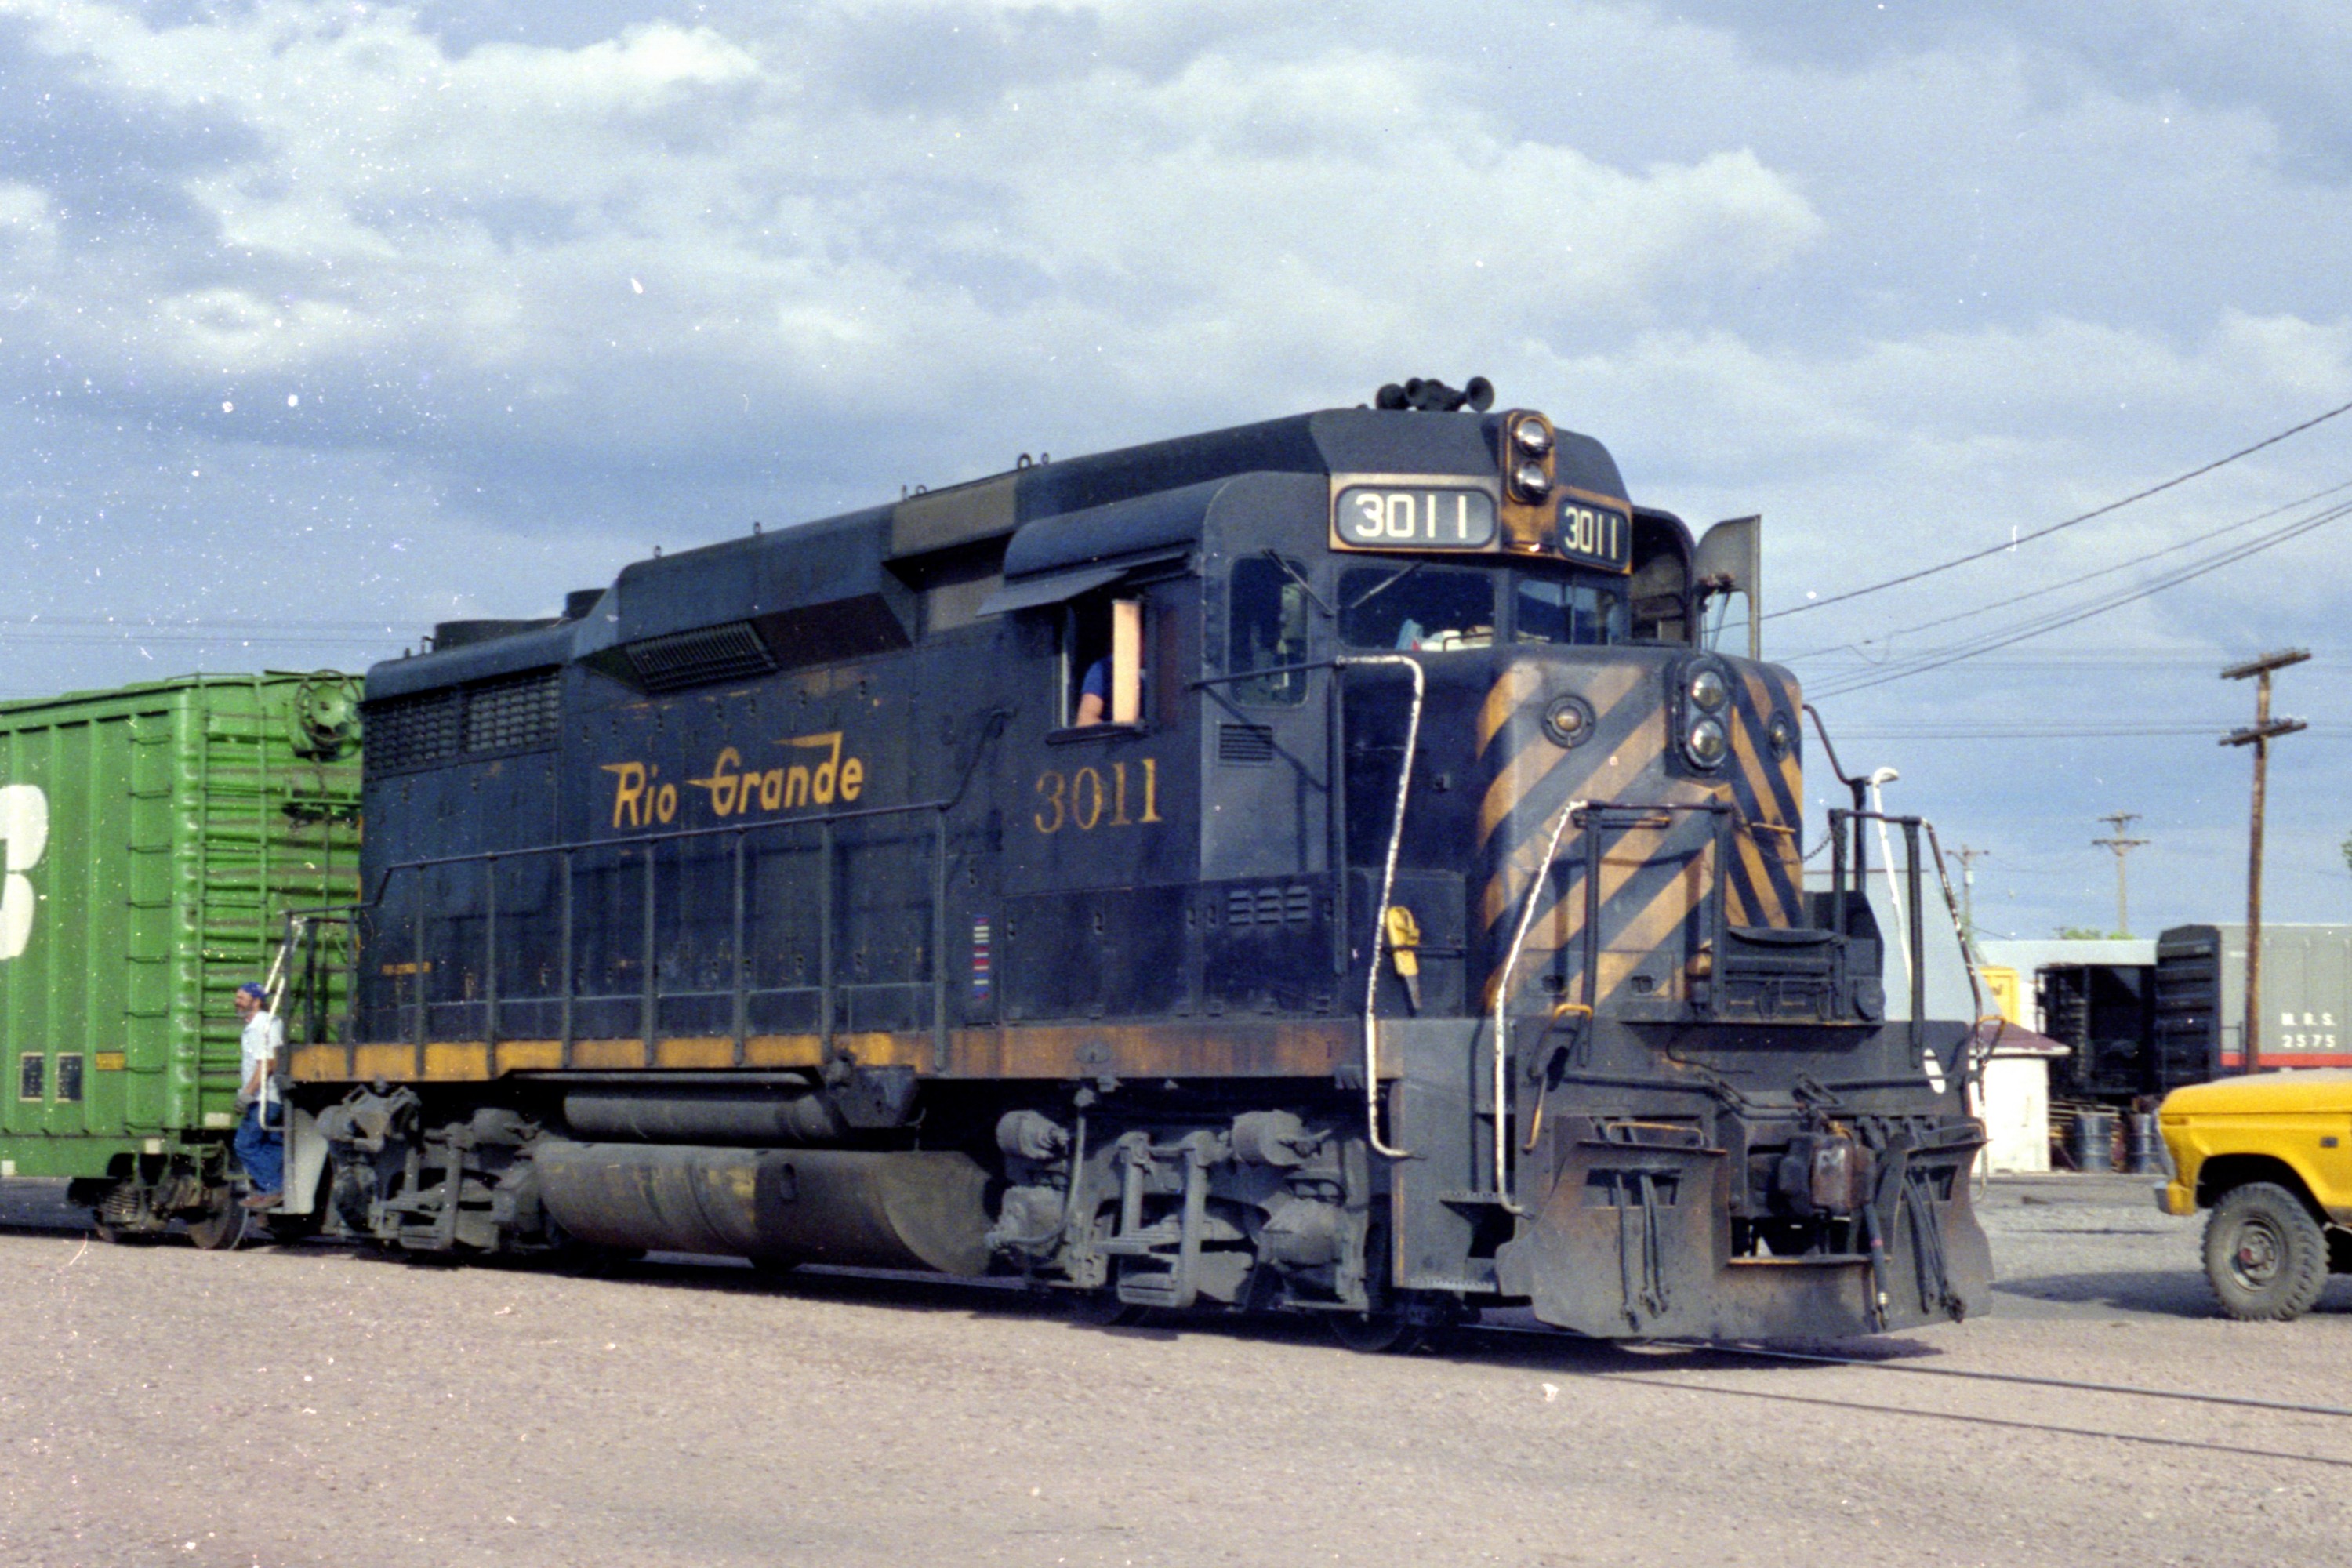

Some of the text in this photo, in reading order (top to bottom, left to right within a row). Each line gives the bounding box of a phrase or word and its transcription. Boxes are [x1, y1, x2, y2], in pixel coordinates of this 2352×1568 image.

[1356, 493, 1467, 539] 3011
[1564, 506, 1617, 560] 3011
[600, 731, 863, 828] Rio Grande
[1035, 757, 1163, 833] 3011
[2282, 1034, 2336, 1047] 2575
